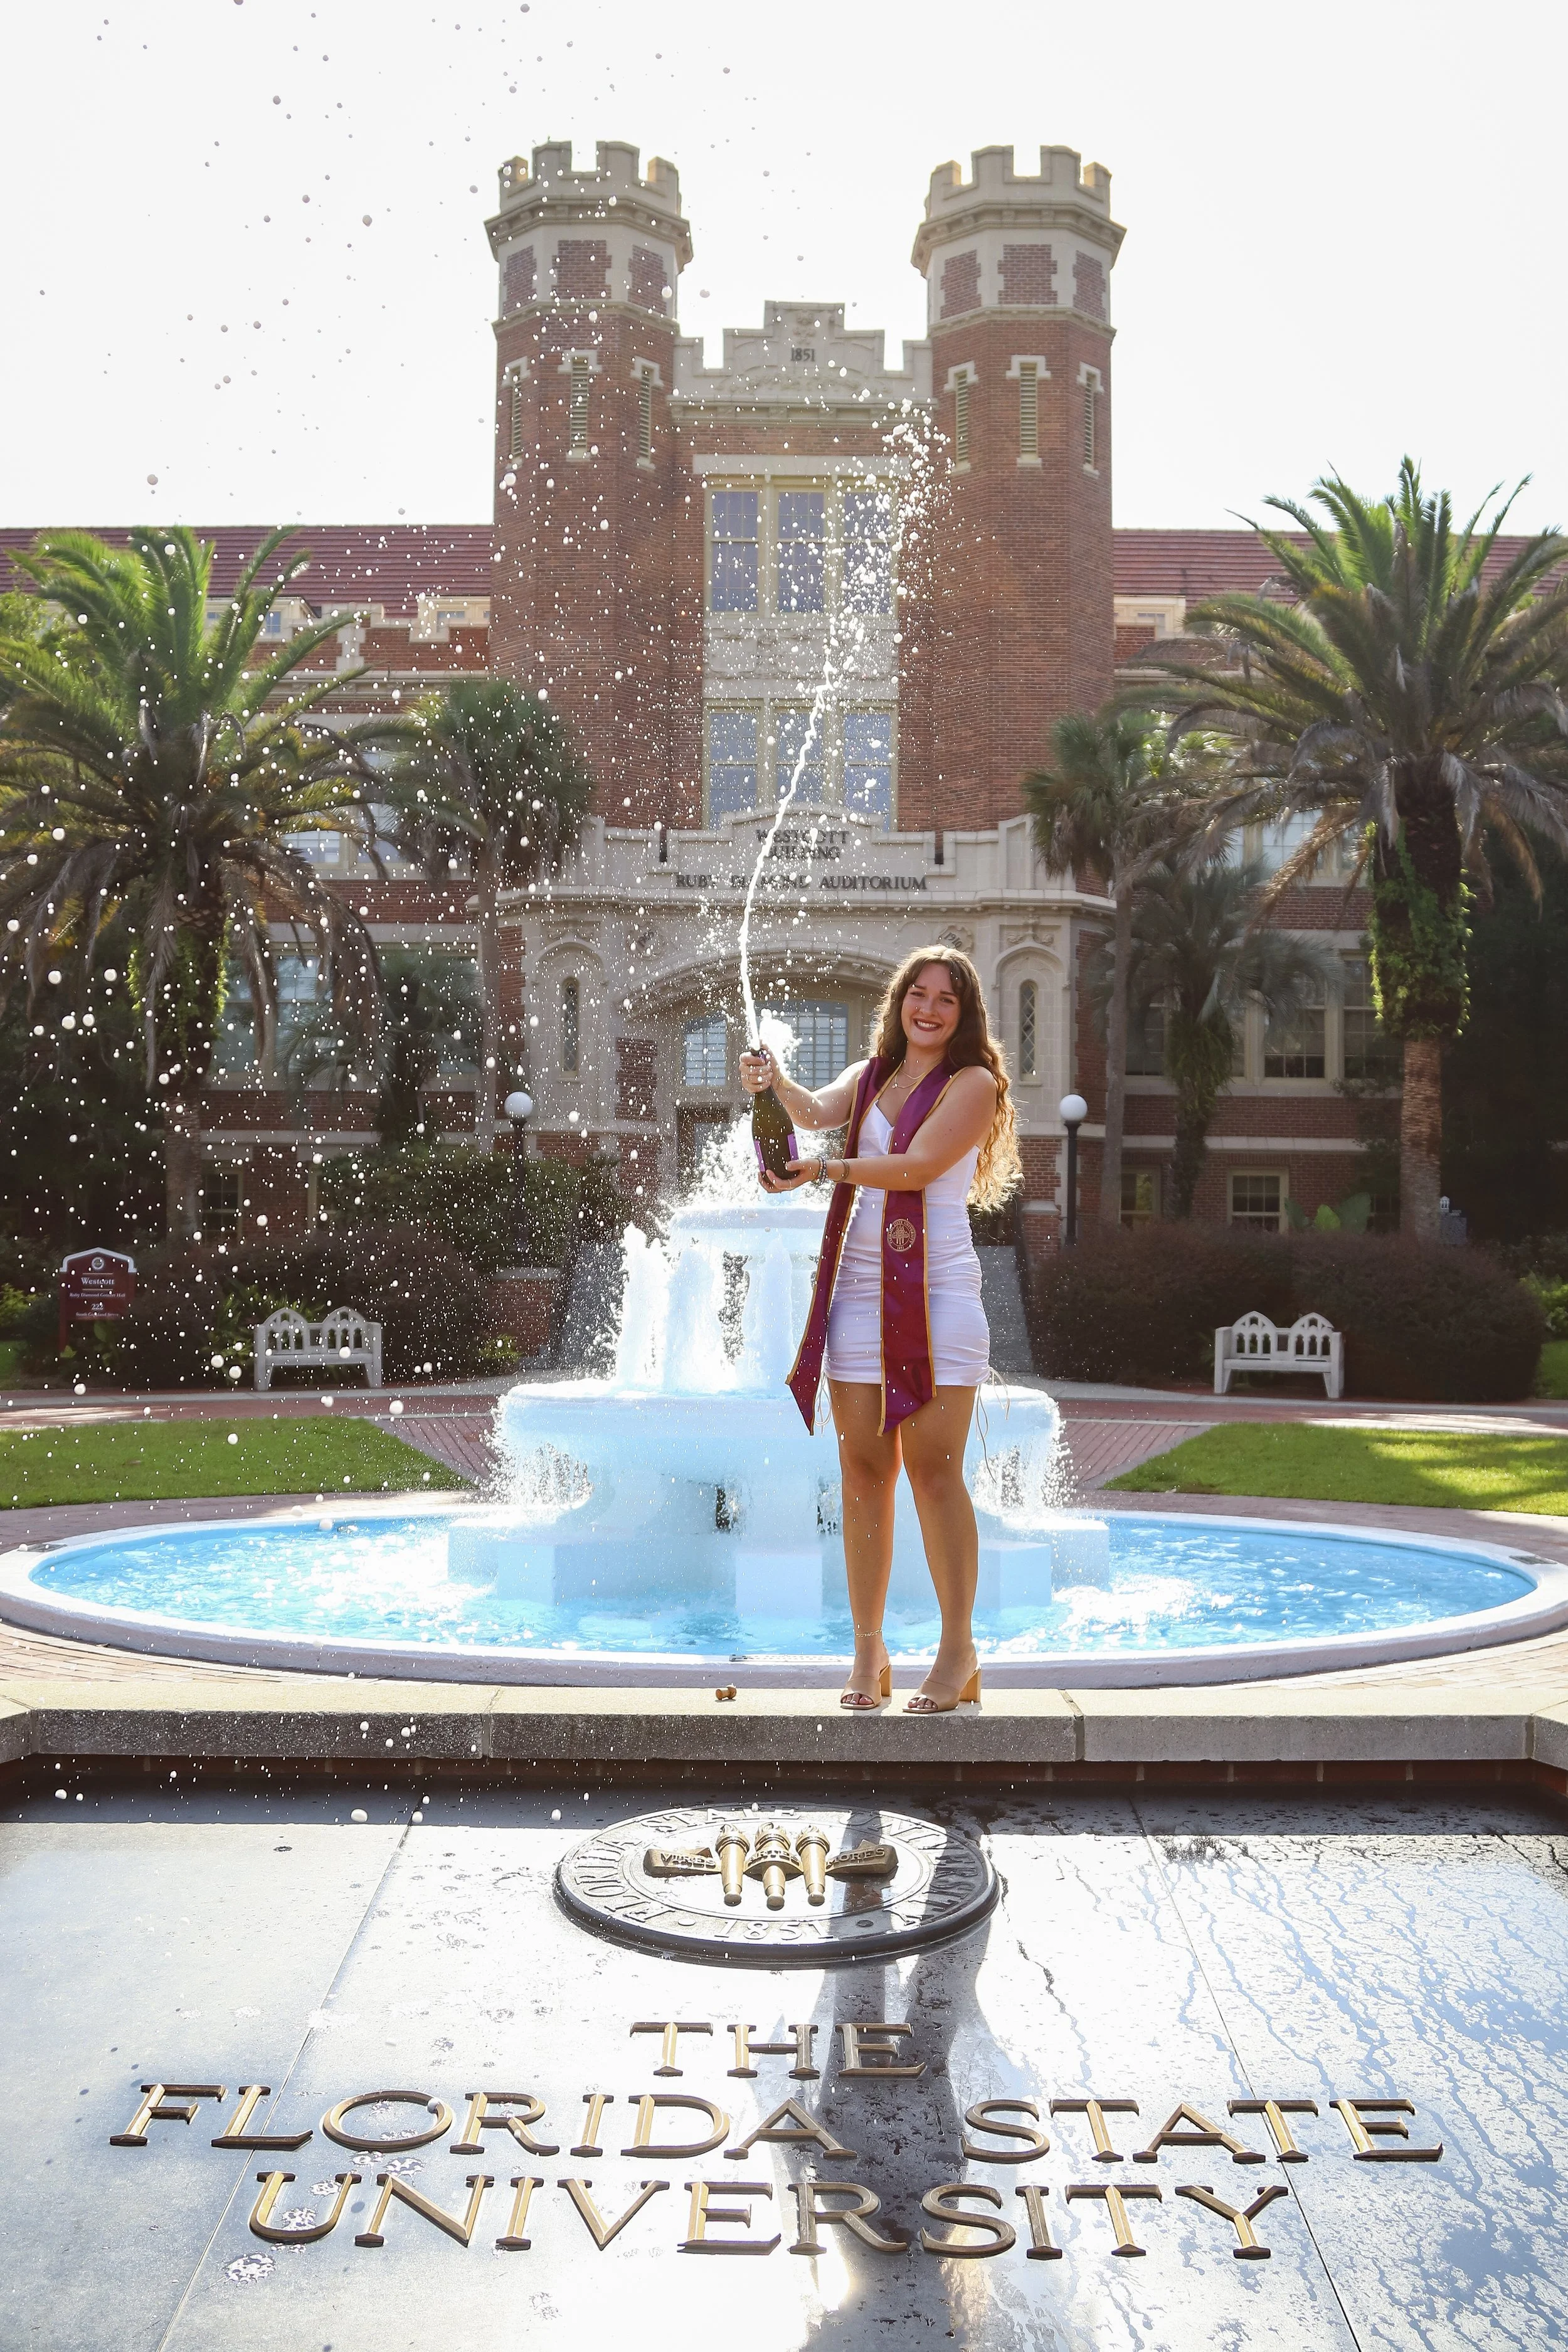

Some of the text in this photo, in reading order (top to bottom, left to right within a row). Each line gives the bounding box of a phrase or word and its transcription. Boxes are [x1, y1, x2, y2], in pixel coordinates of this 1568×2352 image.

[790, 347, 815, 362] 1851
[756, 829, 849, 844] WESTCOTT
[762, 845, 841, 859] UILDING
[819, 875, 927, 890] AUDITORIUM
[943, 932, 963, 948] 1910
[573, 1806, 979, 1926] FLORIDA STATE UNIVERSITY
[660, 1852, 717, 1869] VIRES
[826, 1847, 886, 1867] MORES
[714, 1920, 835, 1940] 1851
[630, 2020, 926, 2081] THE
[109, 2082, 1444, 2165] FLORIDA STATE
[249, 2171, 1290, 2261] UNIVERSITY
